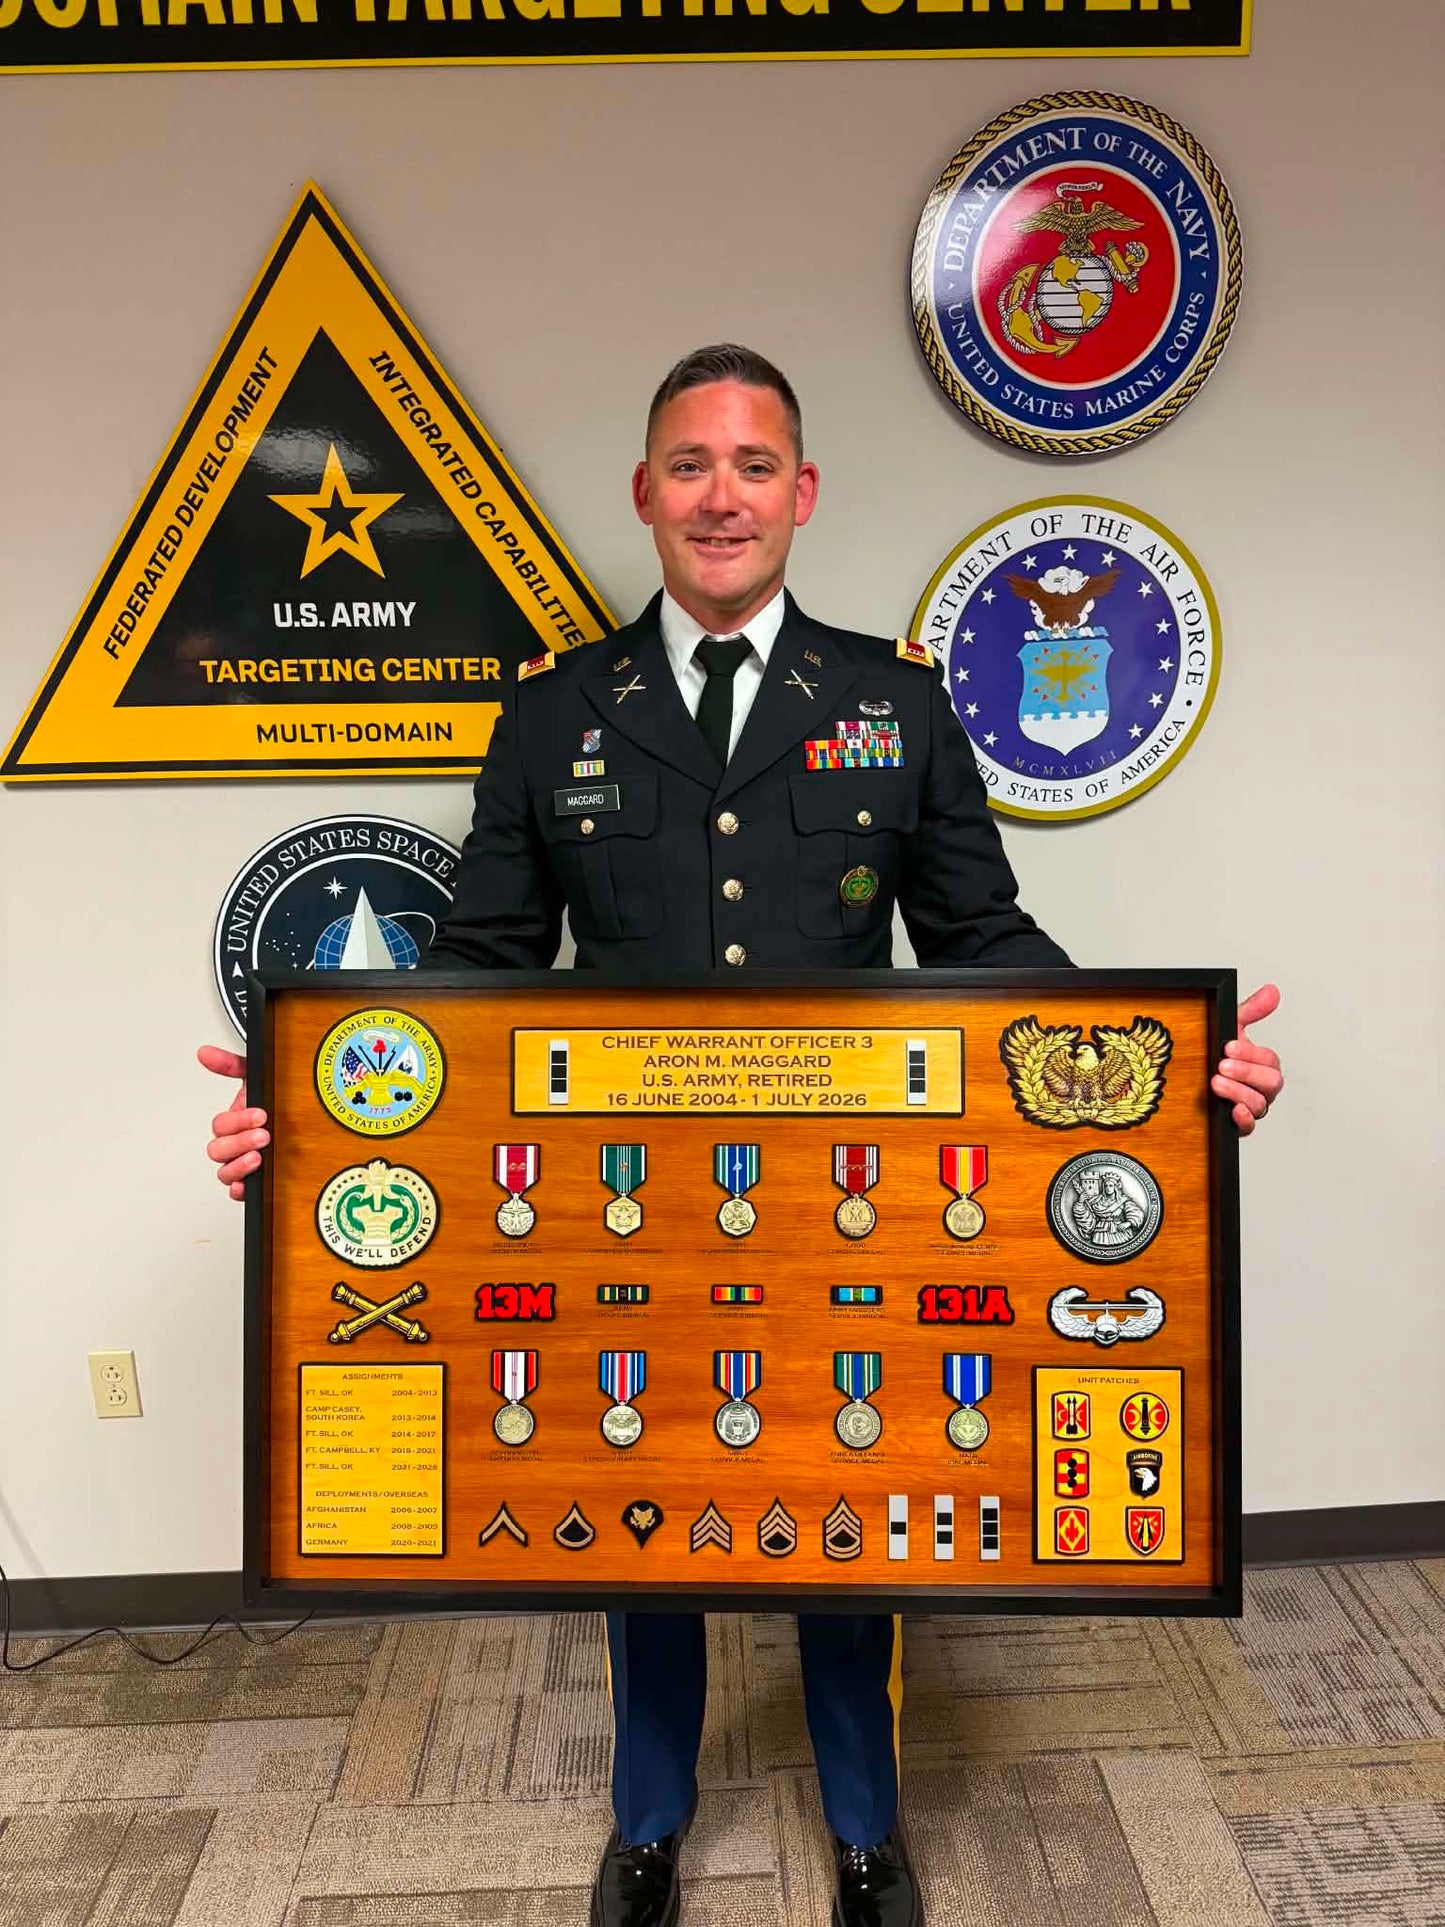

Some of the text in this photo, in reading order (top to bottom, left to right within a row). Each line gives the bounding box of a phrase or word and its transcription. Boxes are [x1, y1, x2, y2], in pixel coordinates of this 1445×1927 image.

[944, 128, 1210, 273] DEPARTMENT OF THE NAVY
[948, 292, 1205, 419] UNITED STATES MARINE CORPS
[369, 350, 482, 512] INTEGRATED
[103, 347, 279, 660] FEDERATED DEVELOPMENT
[274, 601, 416, 628] U.S. ARMY
[1031, 514, 1063, 538] OF
[1081, 513, 1133, 543] THE
[1140, 543, 1179, 583] AIR
[1177, 589, 1206, 687] FORCE
[199, 657, 501, 685] TARGETING CENTER
[256, 722, 453, 744] MULTI-DOMAIN
[1007, 782, 1074, 803] STATES
[1085, 779, 1110, 798] OF
[1120, 718, 1187, 784] AMERICA
[1013, 750, 1118, 777] MCMXLVII
[567, 794, 604, 806] MAGGARD
[227, 829, 456, 954] UNITED STATES SPACE
[324, 1016, 438, 1071] DEPARTMENT OF THE ARMY
[601, 1035, 873, 1049] CHIEF WARRANT OFFICER 3
[643, 1055, 832, 1068] ARON M. MAGGARD
[642, 1074, 832, 1089] U.S. ARMY, RETIRED
[324, 1075, 437, 1129] UNITED STATES OF AMERICA
[369, 1107, 392, 1115] 1775
[607, 1093, 628, 1106] 16
[632, 1093, 684, 1106] JUNE
[766, 1093, 813, 1106] JULY
[818, 1093, 867, 1106] 2026
[323, 1215, 431, 1258] THIS WE'LL DEFEND
[478, 1286, 553, 1318] 13M
[921, 1287, 1011, 1321] 131A
